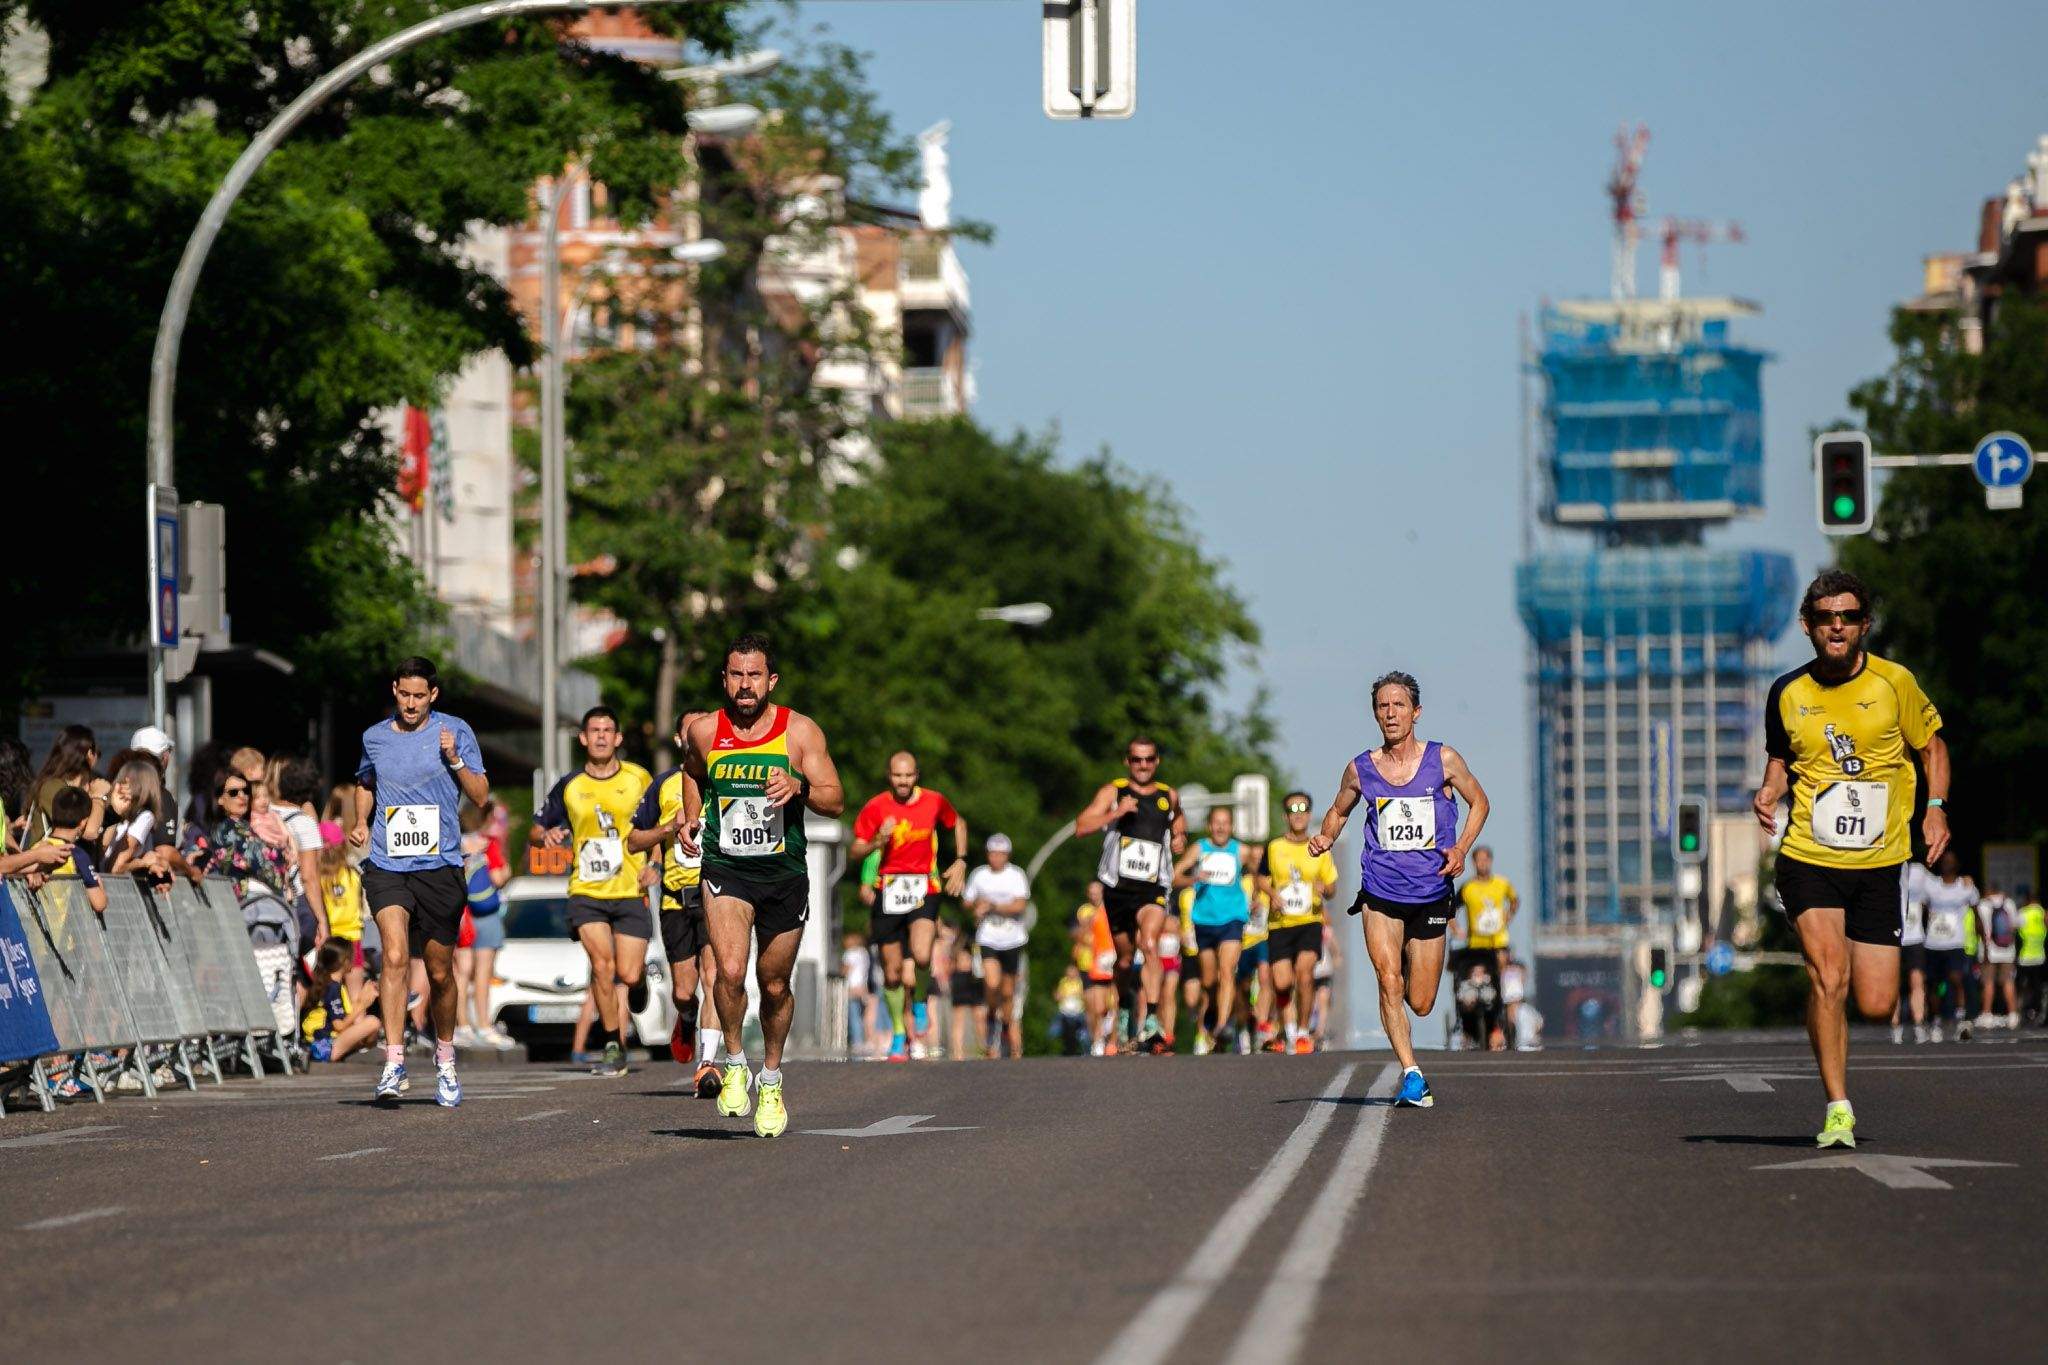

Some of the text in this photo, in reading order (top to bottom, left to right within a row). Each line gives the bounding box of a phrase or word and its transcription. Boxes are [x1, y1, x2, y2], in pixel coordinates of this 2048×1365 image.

[1844, 759, 1861, 772] 13
[1387, 824, 1424, 841] 1234
[1835, 815, 1866, 836] 671
[393, 831, 430, 847] 3008
[731, 827, 772, 845] 3091
[590, 860, 610, 873] 139
